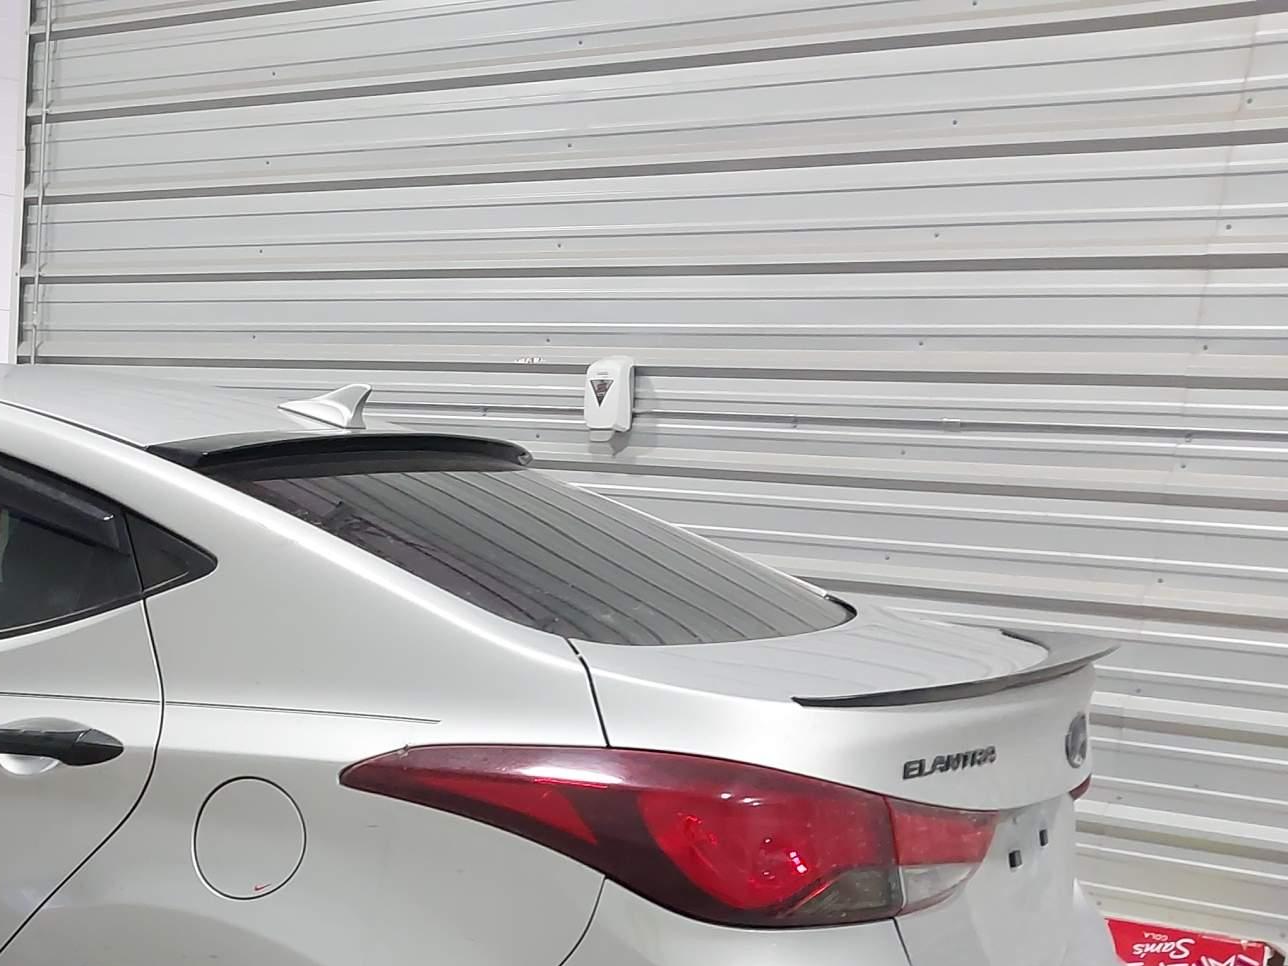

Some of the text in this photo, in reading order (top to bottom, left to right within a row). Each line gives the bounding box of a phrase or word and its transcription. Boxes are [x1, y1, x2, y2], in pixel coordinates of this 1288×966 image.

[903, 746, 996, 780] ELANTRA
[1144, 931, 1169, 941] COLA
[1132, 938, 1195, 959] Sam's
